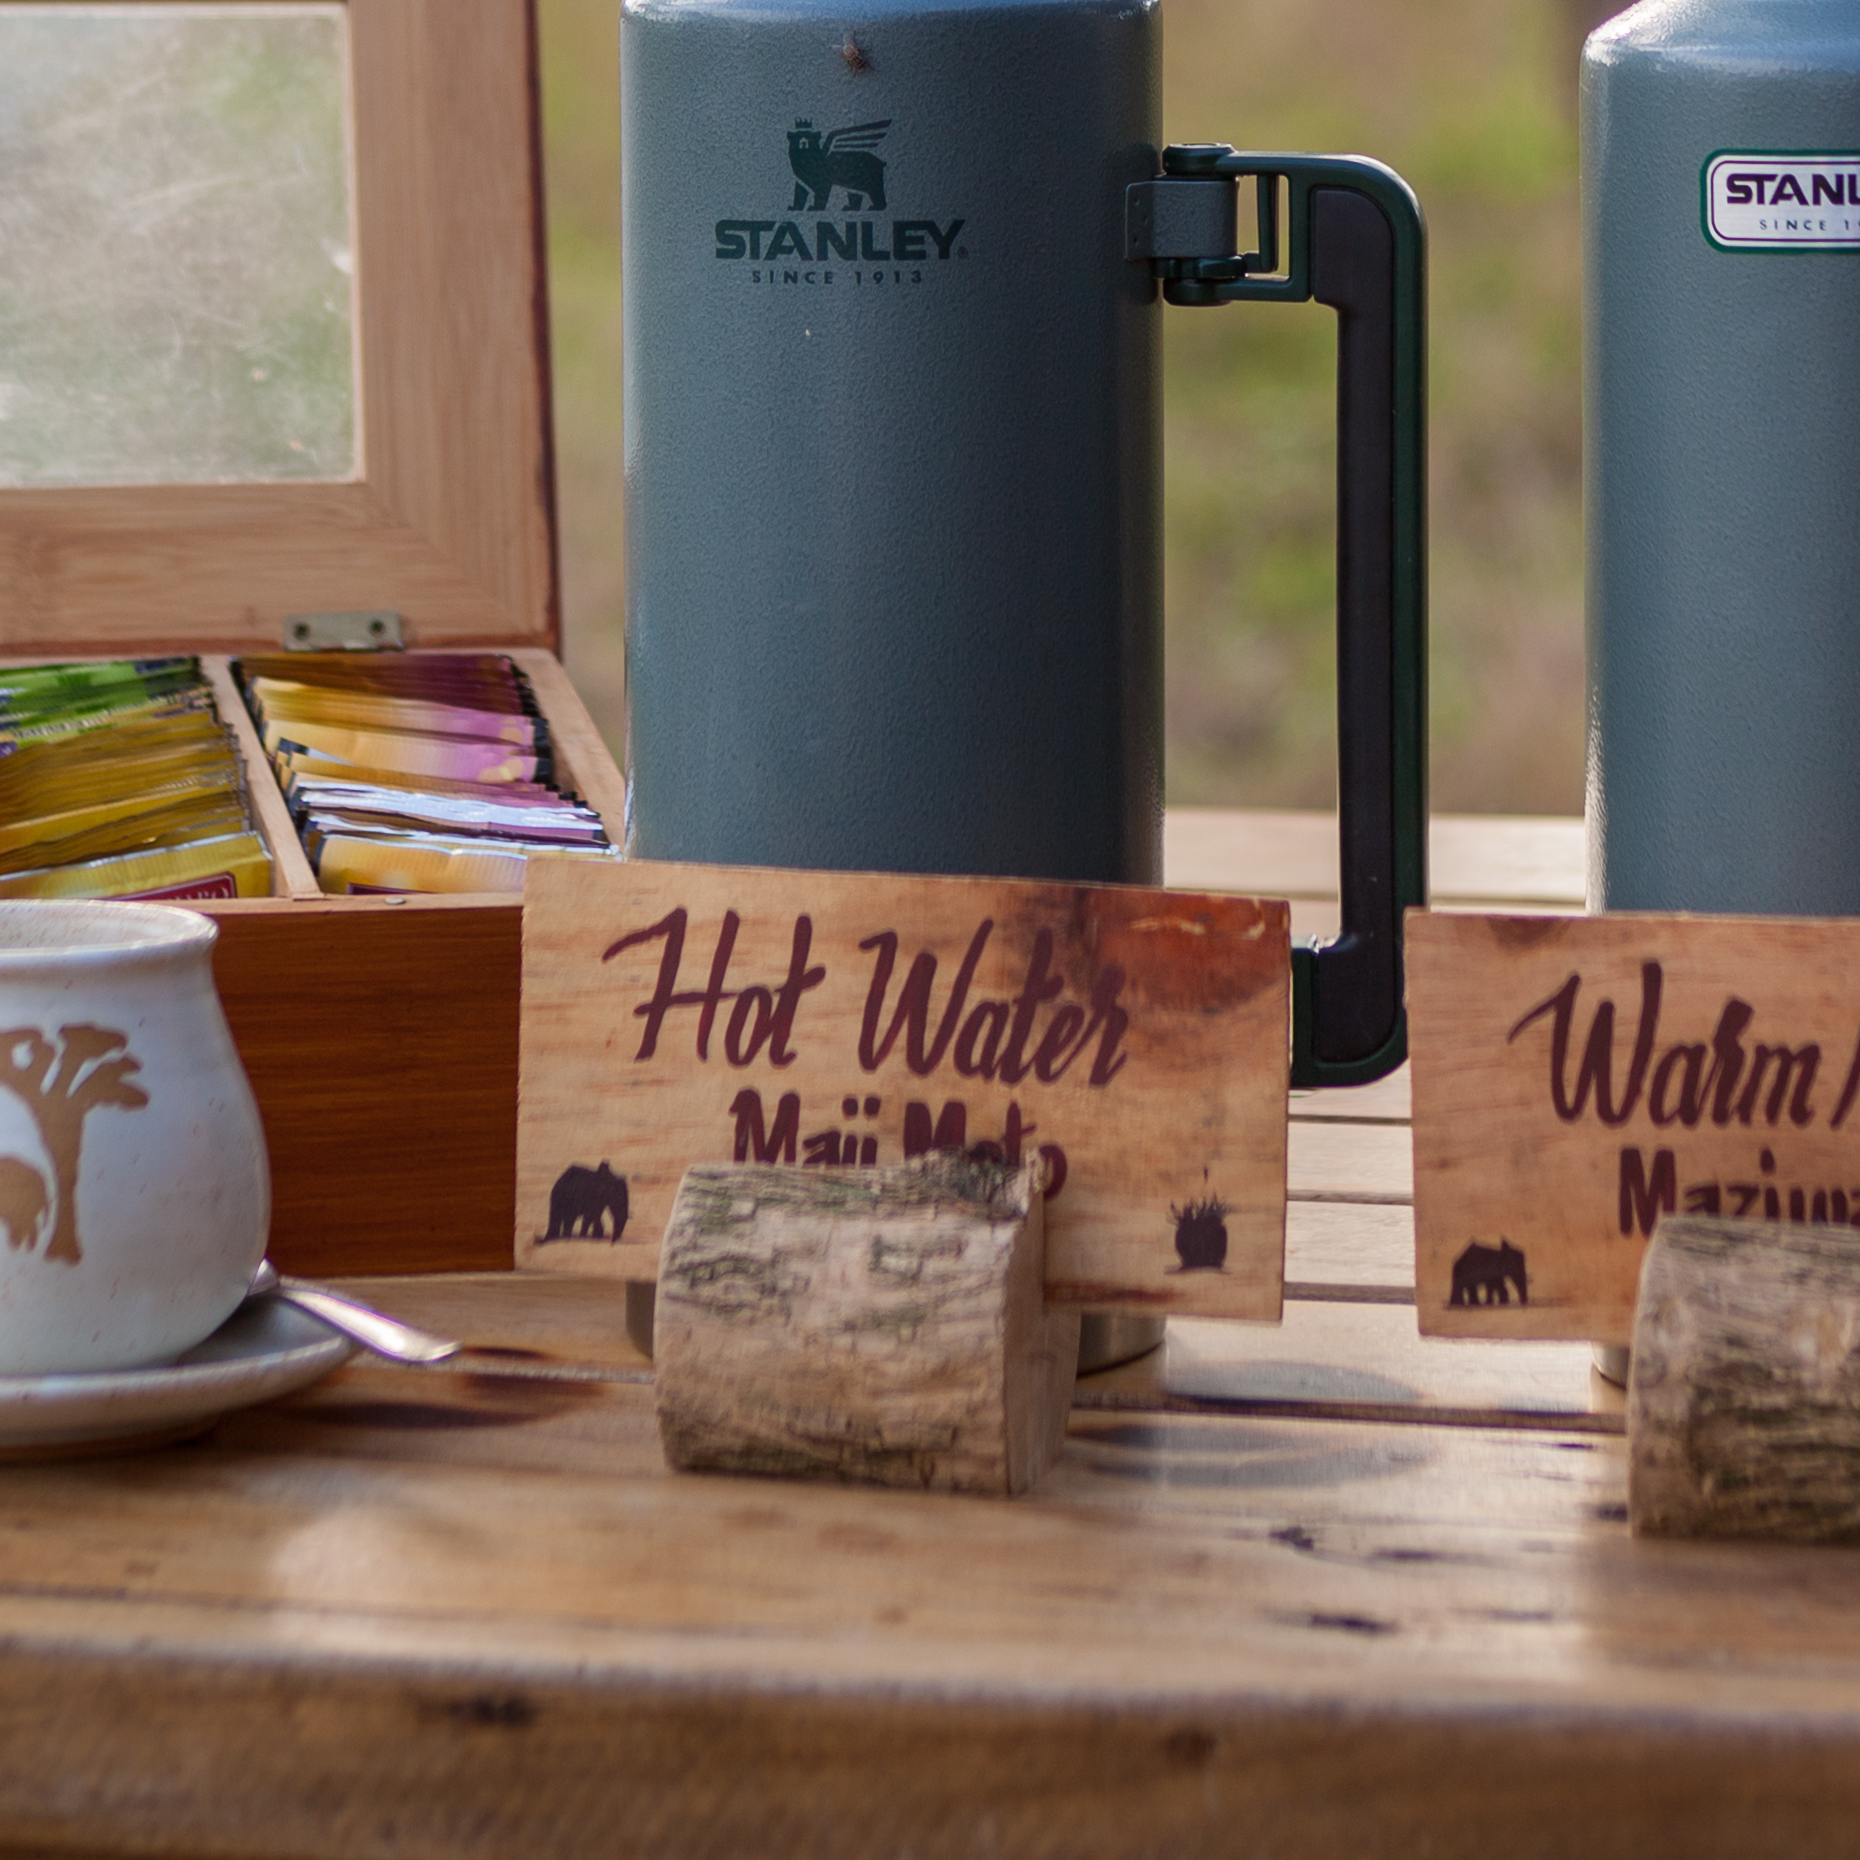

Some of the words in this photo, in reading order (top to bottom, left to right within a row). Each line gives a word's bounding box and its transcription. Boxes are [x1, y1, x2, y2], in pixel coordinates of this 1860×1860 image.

[715, 219, 967, 261] STANLEY
[1759, 219, 1827, 231] SINCE
[752, 270, 834, 285] SINCE
[854, 270, 923, 286] 1913
[601, 906, 827, 1068] Hot
[858, 917, 1130, 1087] Water
[1507, 960, 1823, 1128] Warm
